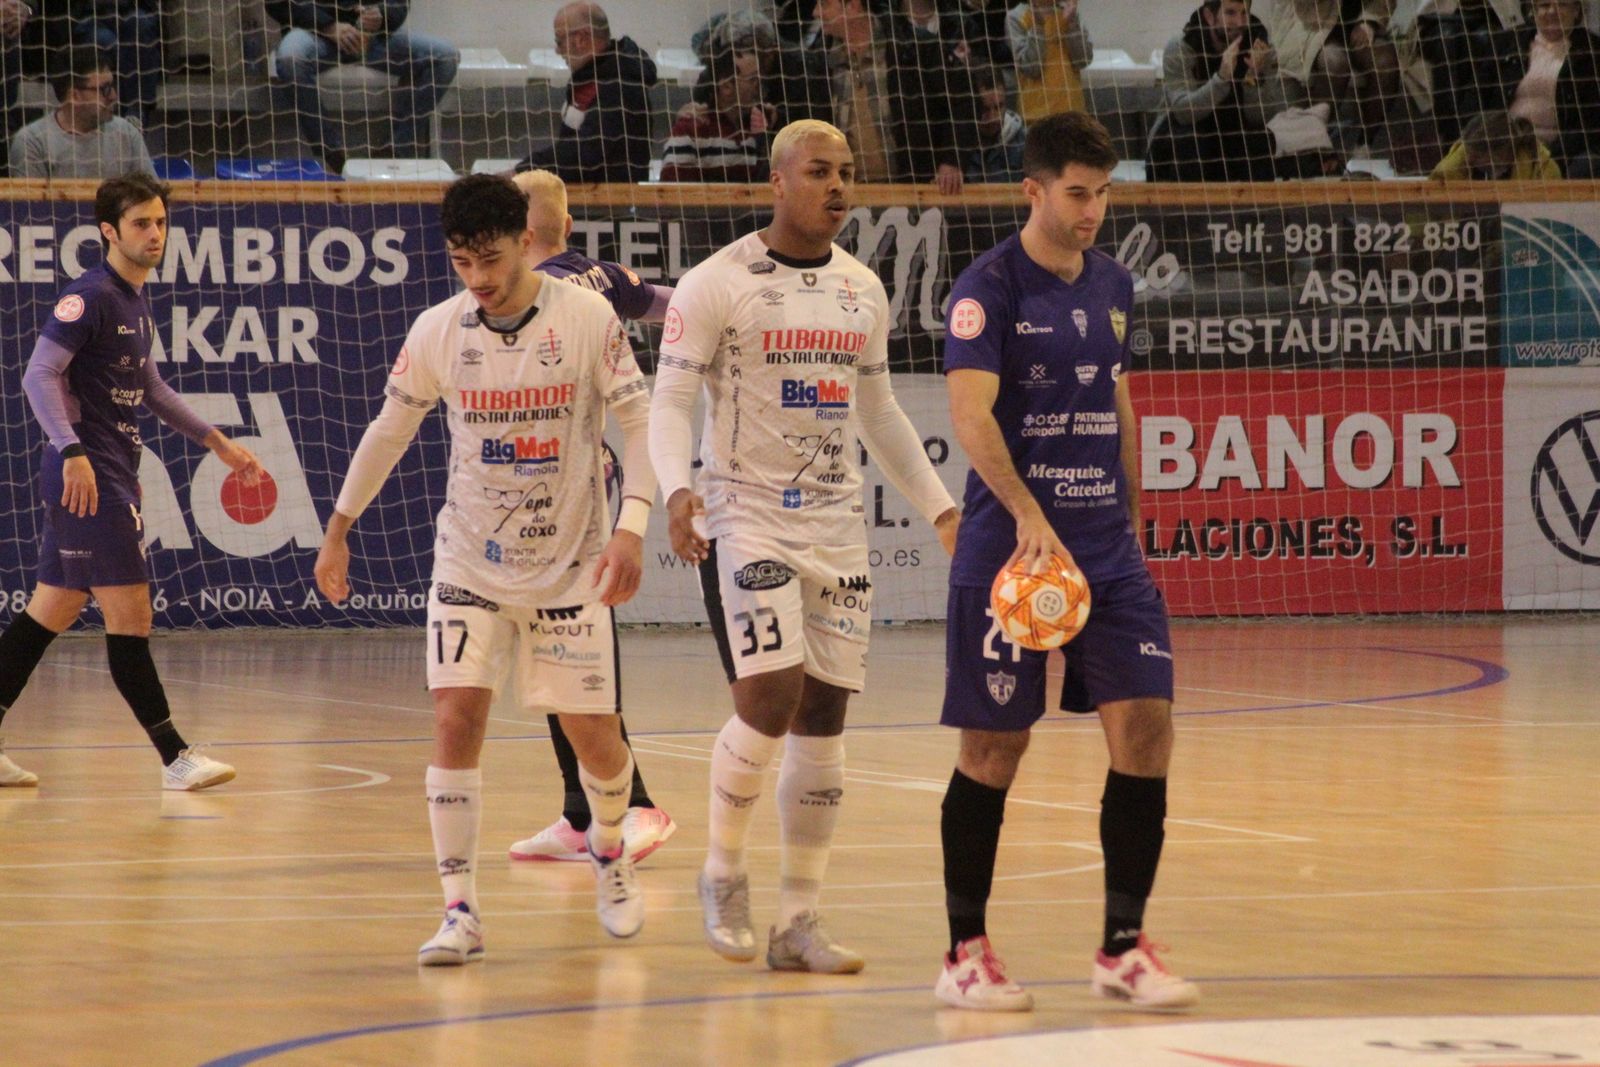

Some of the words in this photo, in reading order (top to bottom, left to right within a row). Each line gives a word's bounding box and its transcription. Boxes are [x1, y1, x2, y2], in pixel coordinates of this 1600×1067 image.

[0, 225, 409, 286] ECMBIOS
[1207, 223, 1272, 253] Telf.
[1285, 222, 1337, 252] 981
[1354, 222, 1411, 251] 822
[1423, 221, 1481, 251] 850
[1300, 268, 1484, 304] ASADOR
[1168, 316, 1488, 354] RESTAURANTE
[459, 383, 576, 410] TUBANOR
[481, 436, 560, 464] BigMat
[1141, 412, 1462, 491] BANOR
[519, 523, 557, 538] coxo
[1144, 515, 1376, 568] LACIONES,
[1390, 515, 1468, 559] S.L.
[200, 588, 275, 611] NOIA
[432, 620, 469, 665] 17
[734, 606, 783, 657] 33
